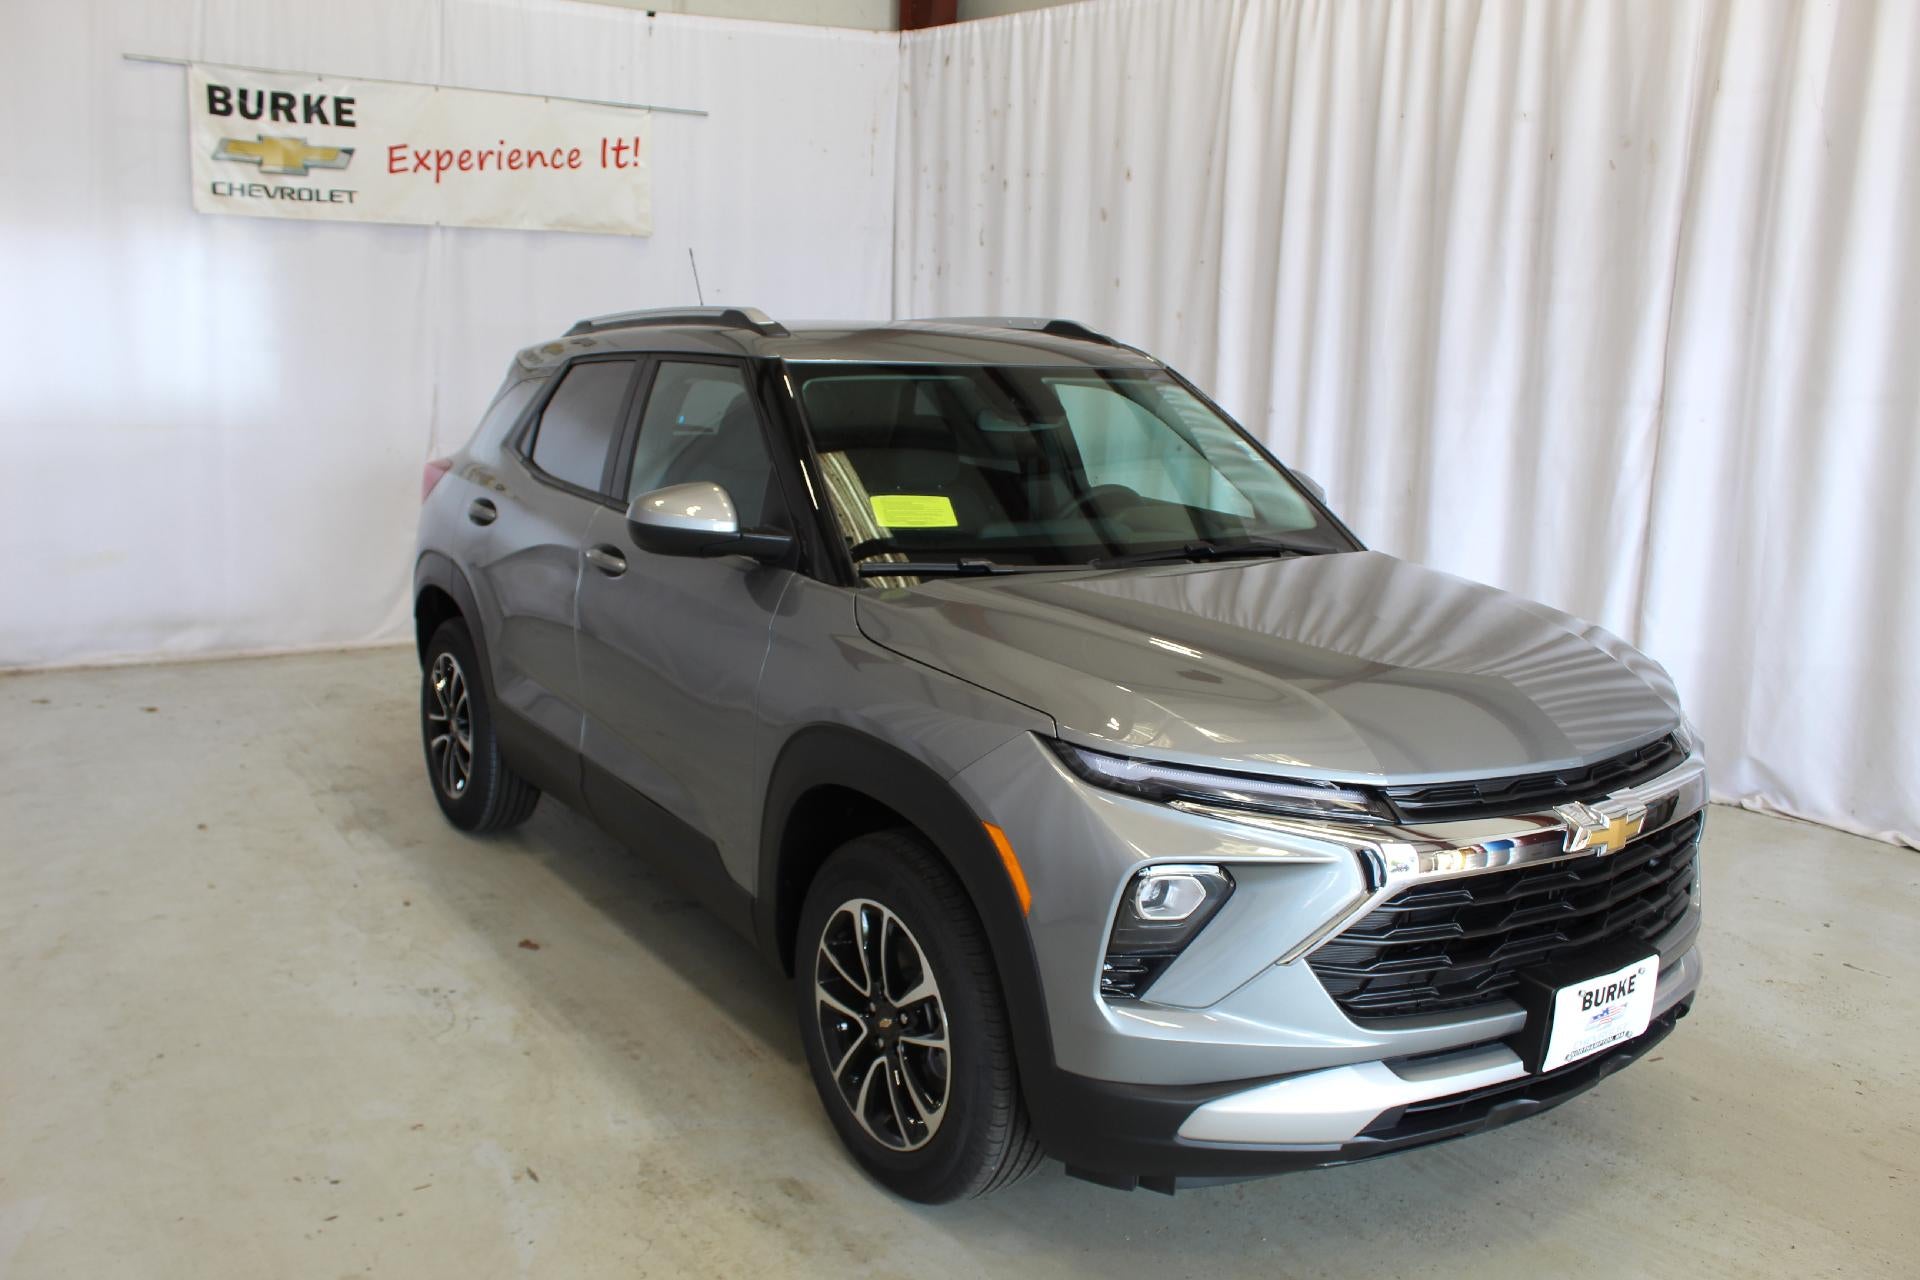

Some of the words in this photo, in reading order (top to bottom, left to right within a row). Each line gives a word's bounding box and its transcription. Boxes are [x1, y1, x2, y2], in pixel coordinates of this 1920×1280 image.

[206, 84, 356, 127] BURKE
[387, 140, 582, 184] Experience
[600, 137, 641, 169] It!
[210, 181, 358, 205] CHEVROLET
[1581, 974, 1637, 1012] BURKE
